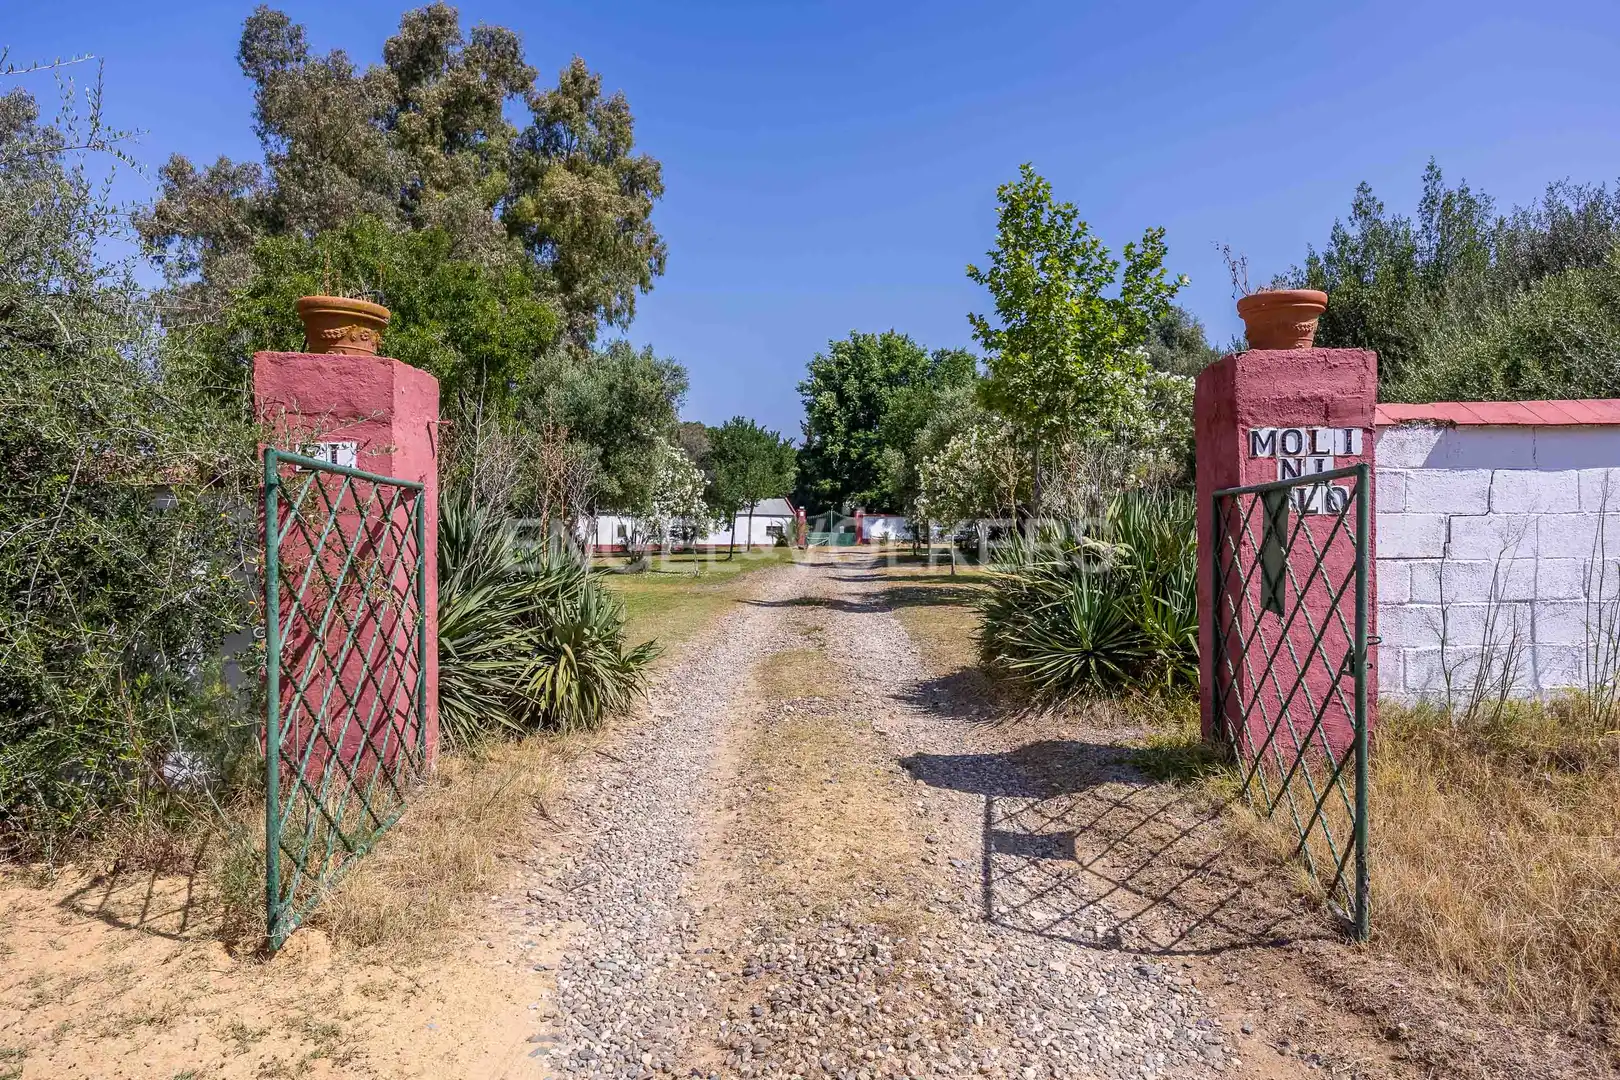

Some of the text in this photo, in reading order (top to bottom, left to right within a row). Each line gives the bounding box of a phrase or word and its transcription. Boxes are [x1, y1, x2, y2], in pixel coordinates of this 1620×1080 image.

[1251, 428, 1354, 457] MOLI
[1281, 458, 1325, 481] NI
[1295, 486, 1349, 514] LO
